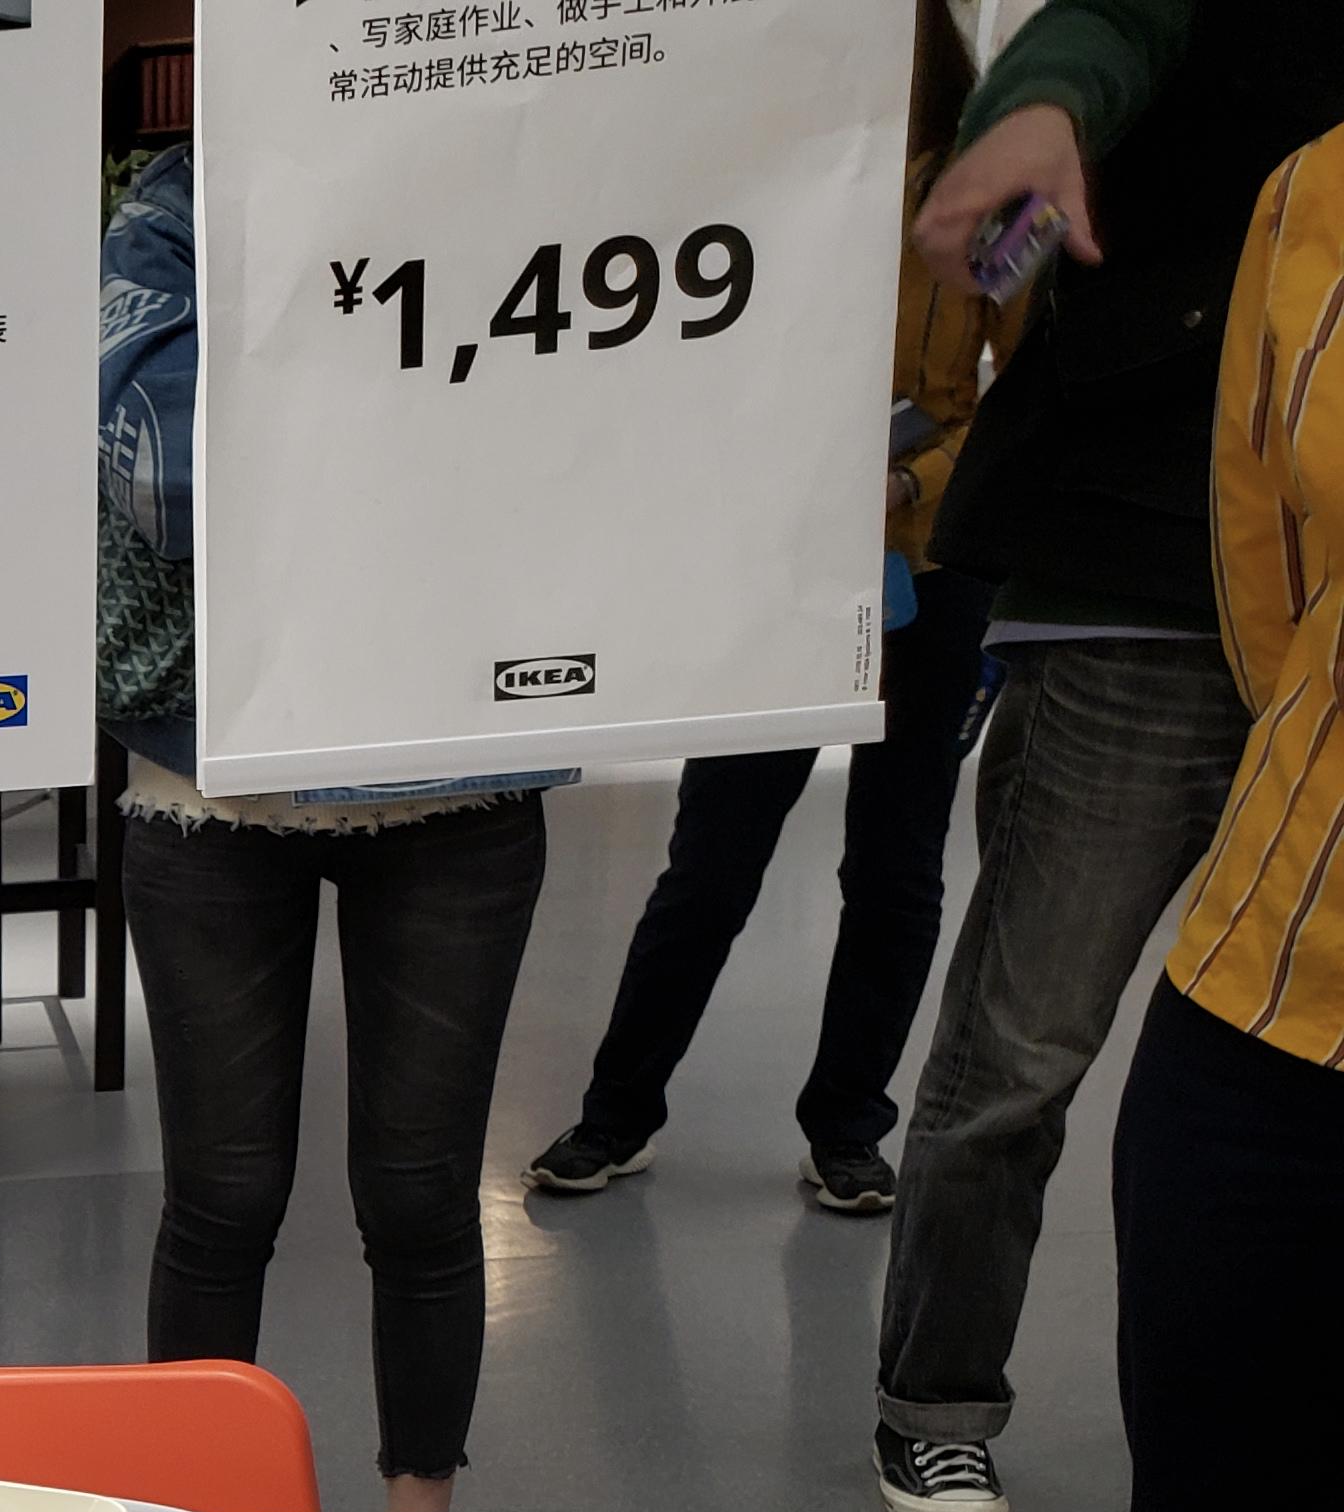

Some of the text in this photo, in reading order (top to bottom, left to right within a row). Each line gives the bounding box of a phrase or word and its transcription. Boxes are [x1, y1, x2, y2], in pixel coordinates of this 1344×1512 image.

[329, 33, 667, 101] 常活动提供充足的空间。
[329, 223, 755, 384] ¥1,499
[505, 667, 587, 688] IKEA
